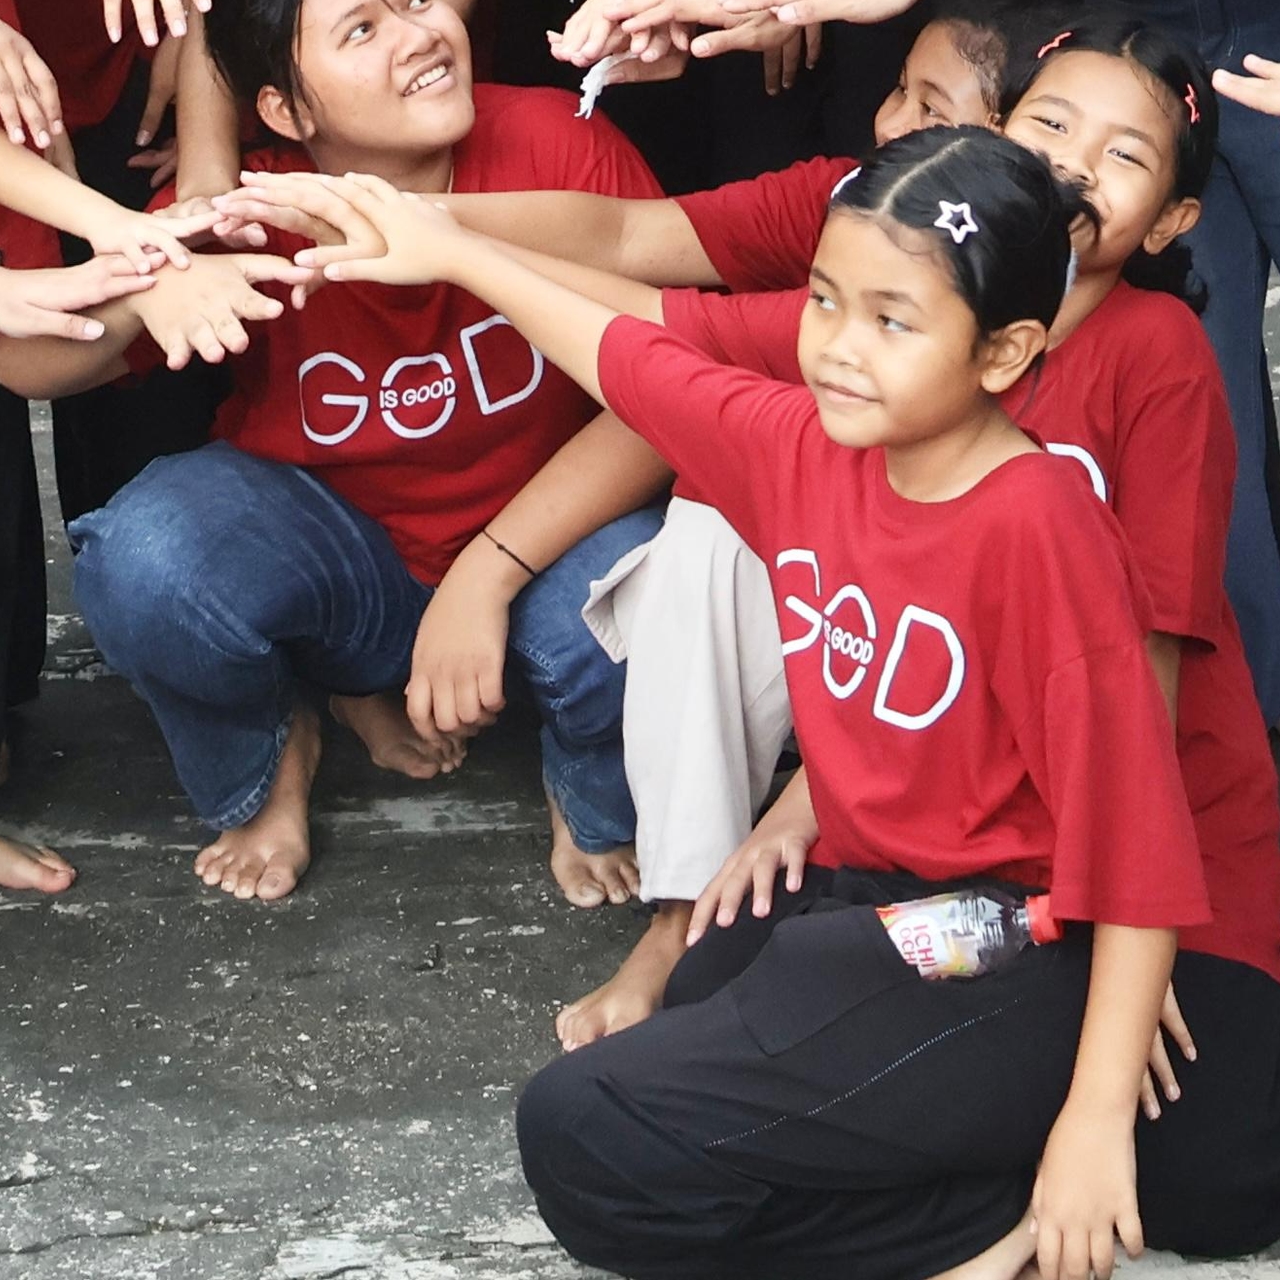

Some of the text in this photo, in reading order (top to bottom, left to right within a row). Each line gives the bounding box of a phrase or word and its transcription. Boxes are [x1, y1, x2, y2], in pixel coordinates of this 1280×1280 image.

[298, 314, 544, 445] GOD
[380, 376, 456, 410] IS GOOD
[830, 626, 874, 666] GOOD
[898, 926, 918, 965] OCH
[913, 923, 938, 968] ICHI
